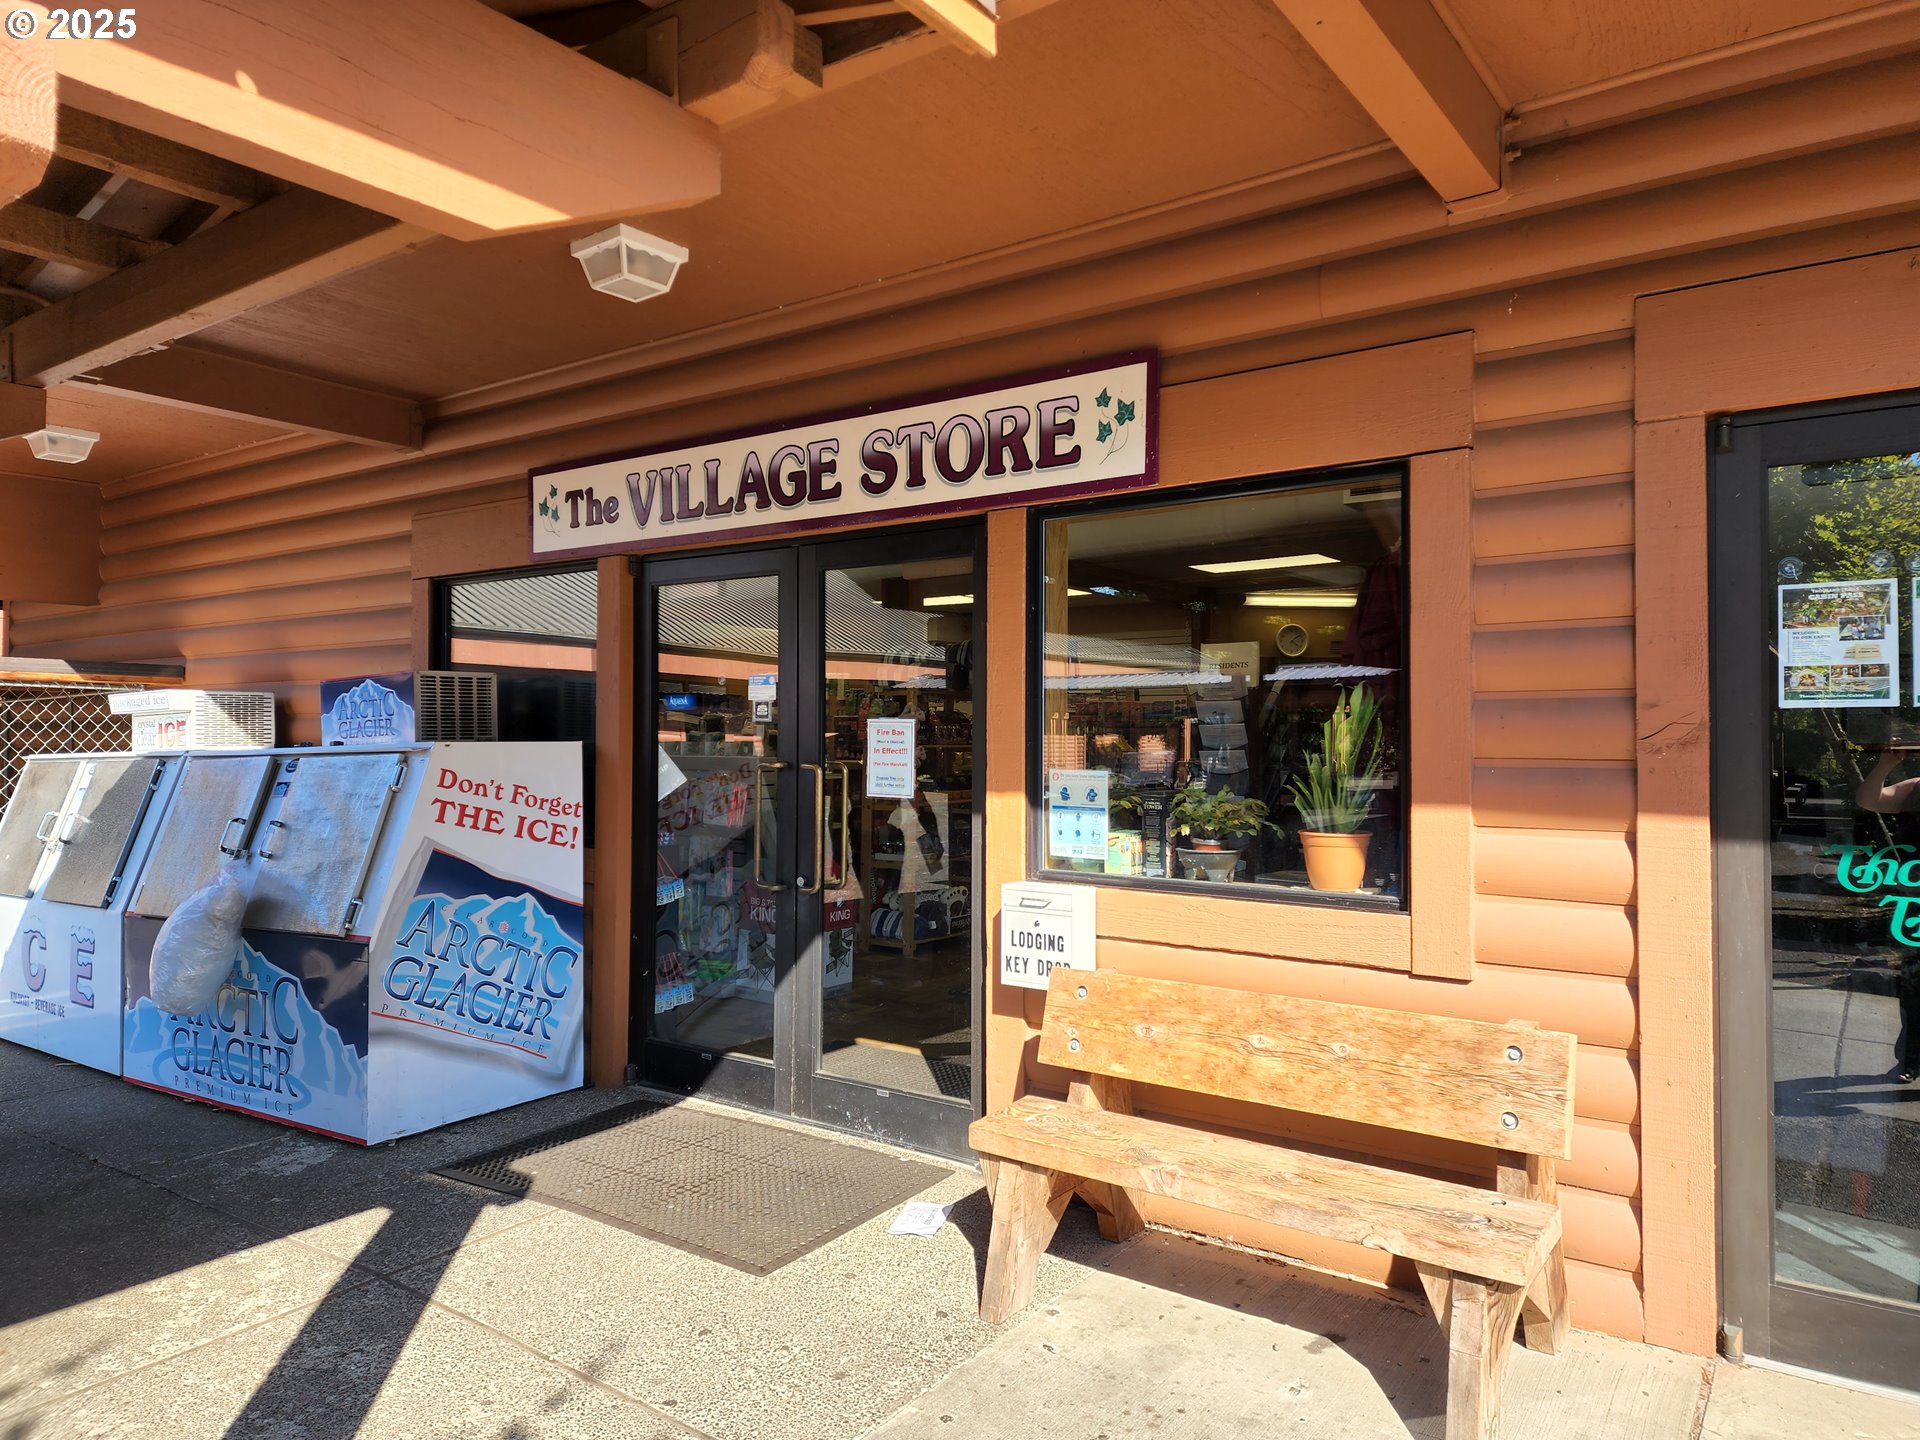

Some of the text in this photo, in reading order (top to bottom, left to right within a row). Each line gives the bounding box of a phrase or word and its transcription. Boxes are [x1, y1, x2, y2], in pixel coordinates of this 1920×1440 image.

[565, 394, 1082, 529] The VILLAGE STORE
[1209, 662, 1249, 670] RESIDENTS
[153, 695, 166, 705] ice
[338, 691, 394, 720] ARCTIC
[158, 717, 187, 747] ICE
[339, 718, 396, 740] GLACIER
[882, 747, 908, 755] Effect!!!
[437, 768, 583, 818] Don't Forget
[431, 798, 579, 849] THE ICE!
[830, 909, 851, 922] KING
[396, 899, 578, 999] ARCTIC
[1011, 930, 1064, 953] LODGING
[1005, 955, 1029, 975] KEY
[383, 955, 552, 1041] GLACIER
[381, 1003, 545, 1054] PREMIUM ICE
[172, 1027, 298, 1098] GLACIER
[175, 1075, 294, 1116] PREMIUM ICE
